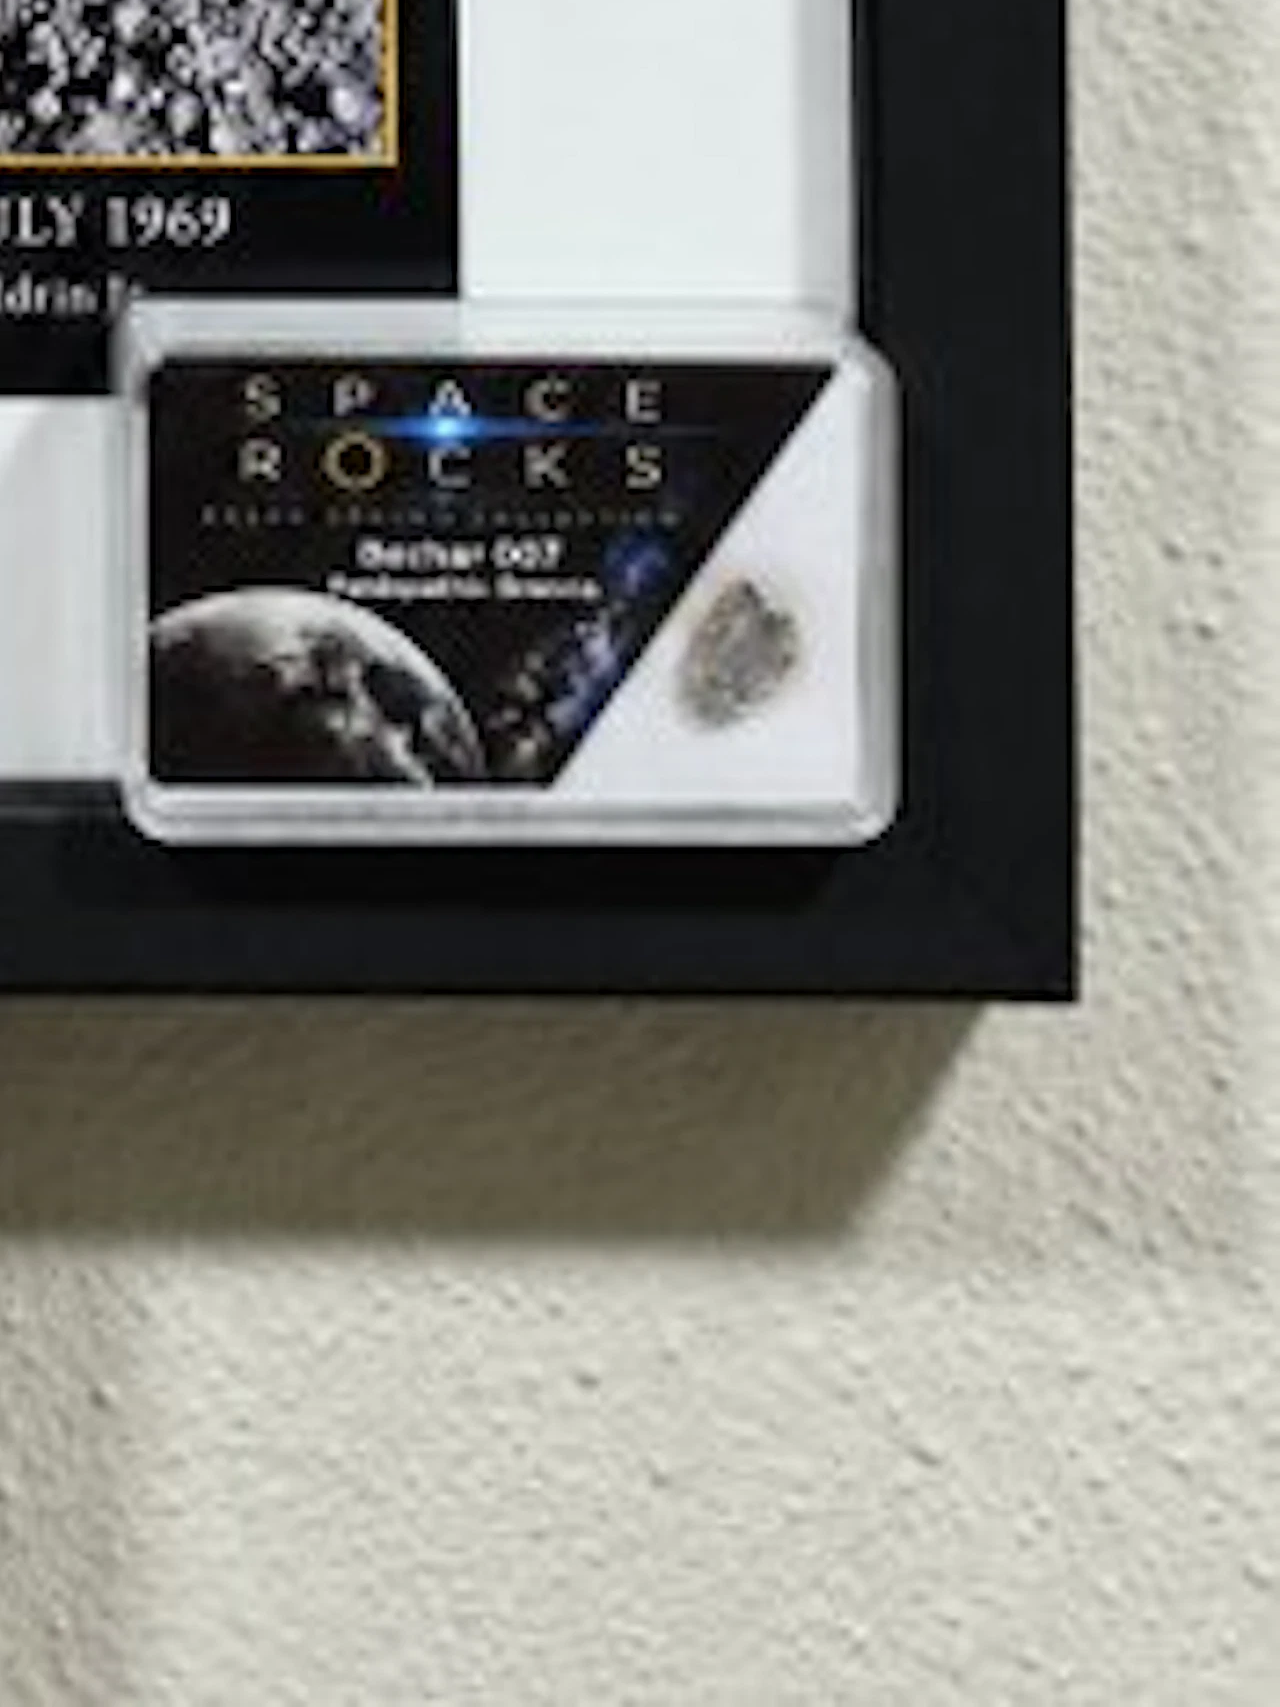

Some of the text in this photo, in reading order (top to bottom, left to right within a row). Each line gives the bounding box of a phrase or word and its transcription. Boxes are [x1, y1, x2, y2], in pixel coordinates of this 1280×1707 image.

[104, 196, 231, 248] 1969
[244, 375, 662, 423] SPACE
[241, 434, 662, 489] ROCKS
[491, 536, 563, 572] 007
